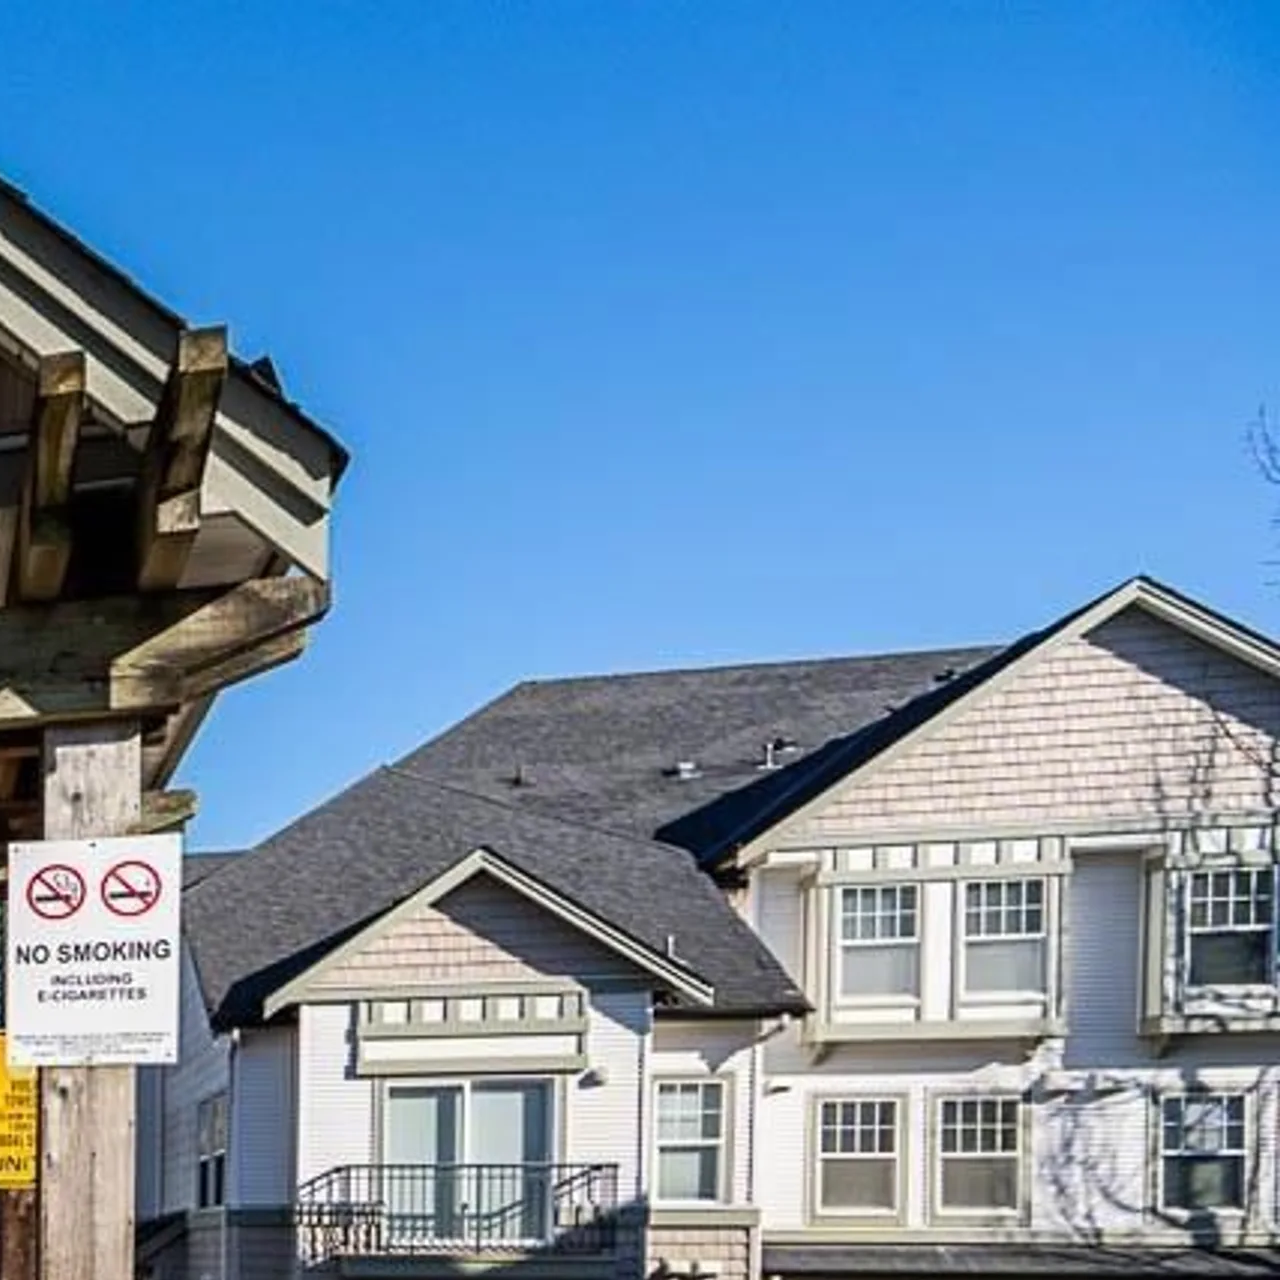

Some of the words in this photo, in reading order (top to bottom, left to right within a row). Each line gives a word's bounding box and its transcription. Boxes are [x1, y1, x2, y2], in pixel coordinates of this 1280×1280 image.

[16, 944, 50, 965] NO
[57, 940, 171, 964] SMOKING
[51, 972, 133, 986] INCLUDING
[38, 987, 147, 1003] E-CIGARETTES
